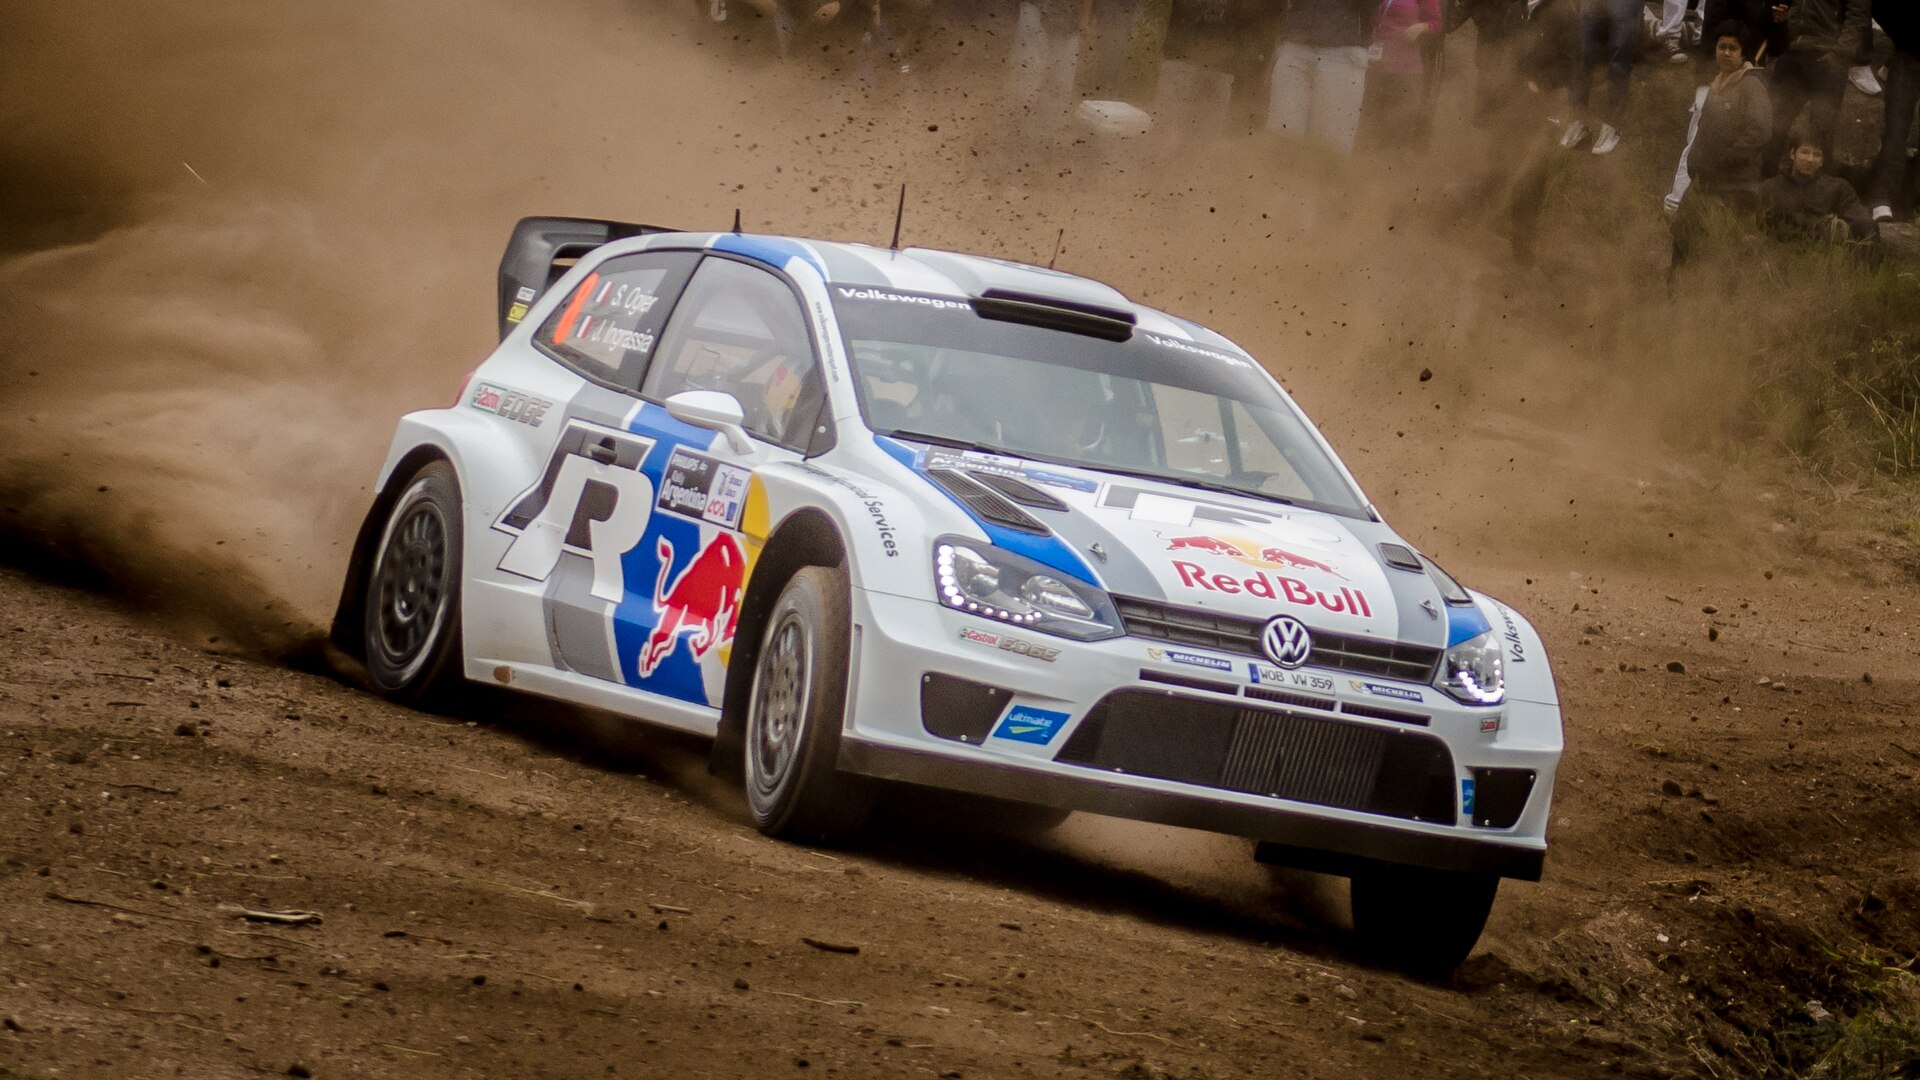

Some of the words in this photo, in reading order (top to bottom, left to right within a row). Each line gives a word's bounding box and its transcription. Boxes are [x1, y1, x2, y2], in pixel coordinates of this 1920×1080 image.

[838, 287, 972, 310] Volkswagen
[602, 321, 654, 353] Ingrassia
[1144, 334, 1253, 369] Volkswagen
[497, 391, 554, 428] EDGE
[660, 477, 708, 511] Argentina
[864, 500, 899, 558] Services
[1172, 560, 1277, 600] Red
[1276, 576, 1372, 618] Bull
[967, 629, 999, 646] Castrol
[998, 636, 1063, 663] EDGE
[1263, 617, 1311, 667] VW
[1173, 653, 1231, 668] MICHELIN
[1259, 668, 1285, 682] WOB
[1291, 673, 1308, 686] VW
[1310, 676, 1334, 690] 359
[1372, 685, 1421, 699] MICHELIN
[1009, 712, 1053, 727] ultimate
